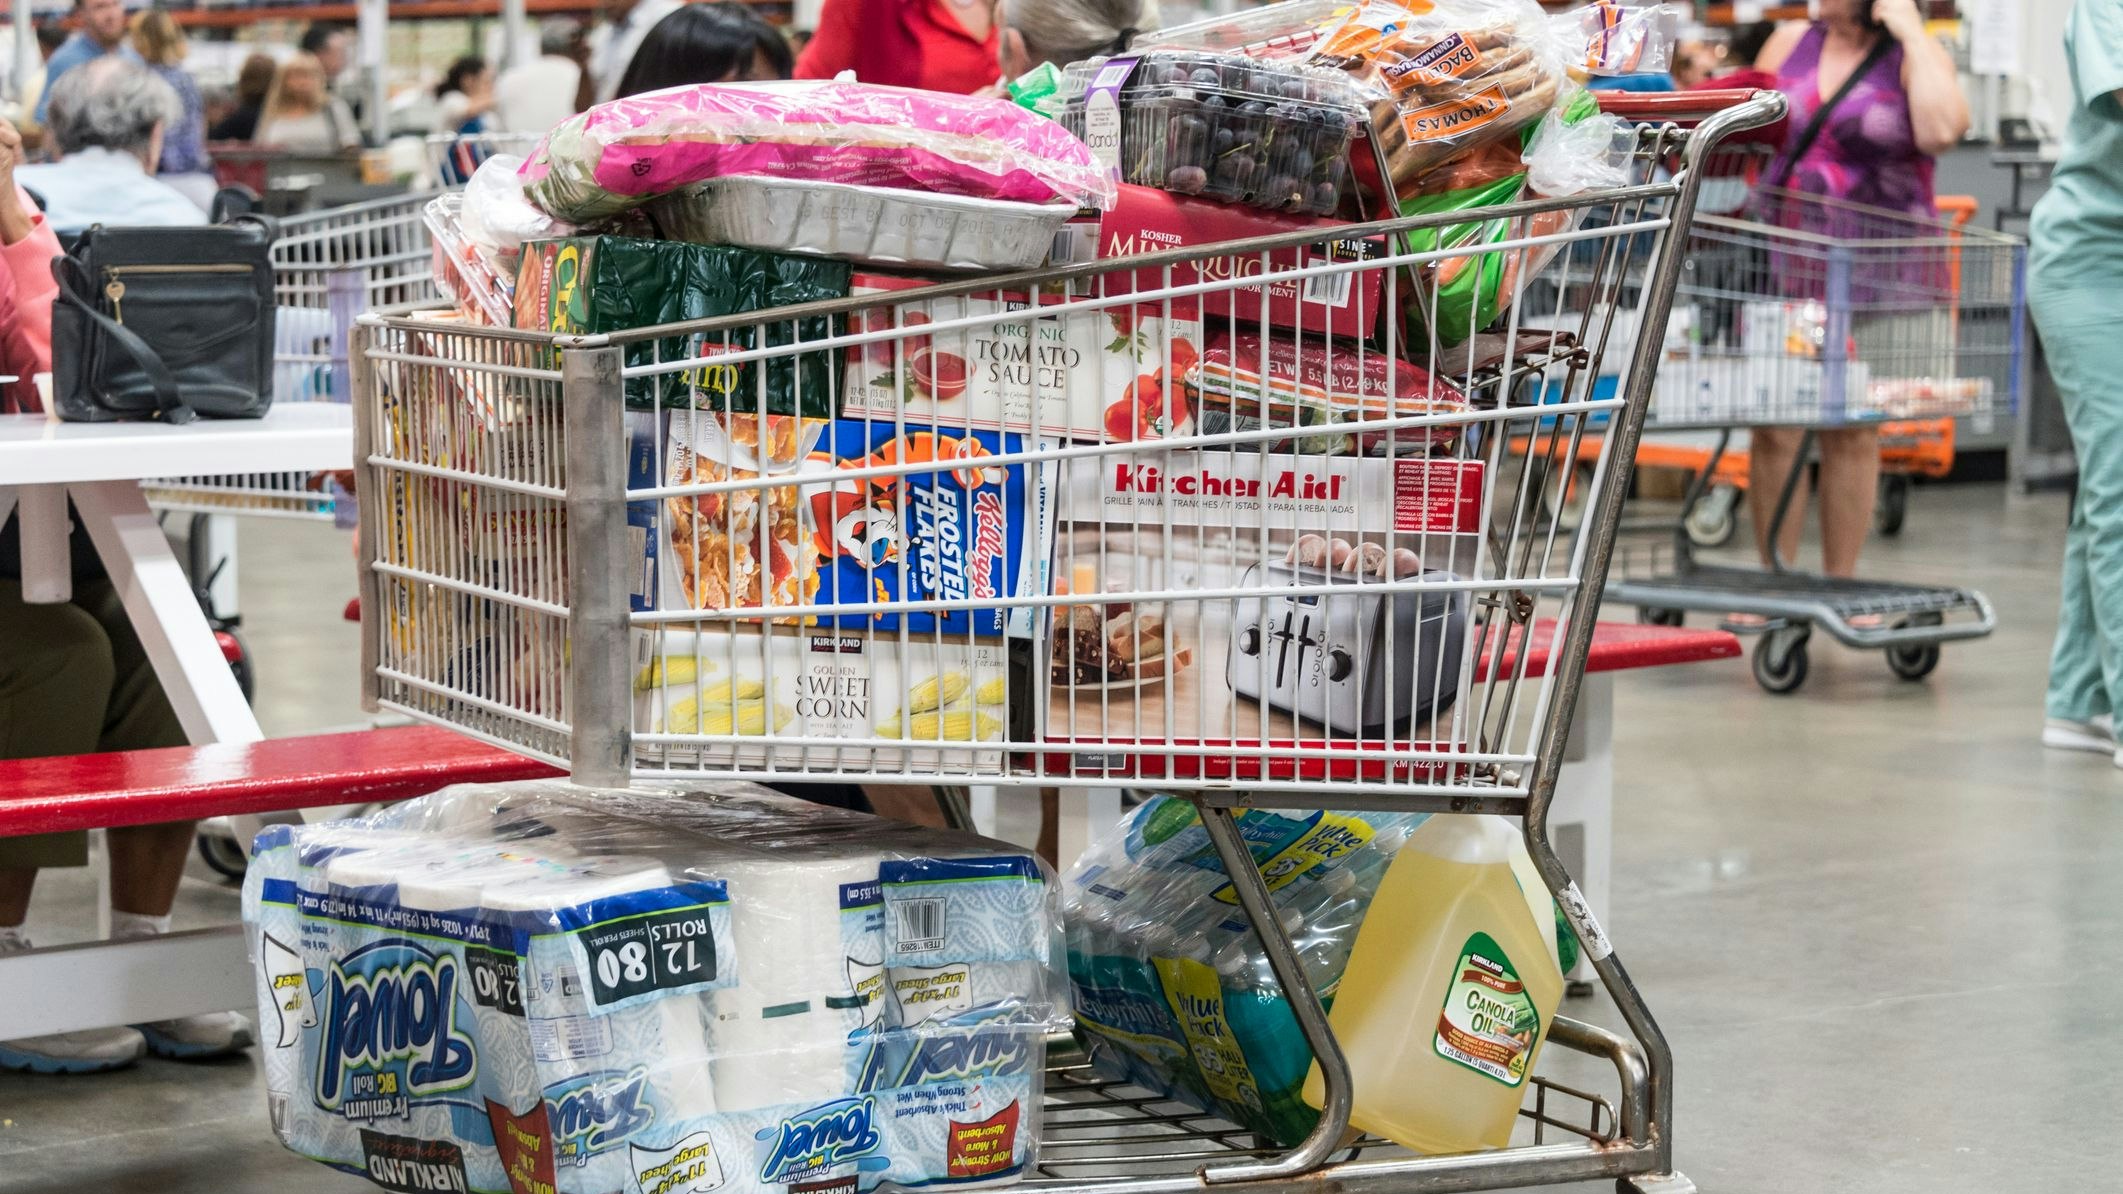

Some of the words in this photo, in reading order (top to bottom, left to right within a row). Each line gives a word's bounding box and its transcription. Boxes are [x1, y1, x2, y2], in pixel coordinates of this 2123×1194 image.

[1140, 229, 1182, 245] KOSHER
[538, 255, 553, 333] ORIGINA
[989, 362, 1065, 389] SAUCE
[1115, 464, 1340, 501] KitchenAid
[1104, 496, 1132, 506] GRILLE
[938, 486, 967, 601] FROSTED
[813, 637, 861, 648] KIRKAND
[977, 649, 988, 660] 12
[796, 698, 869, 721] CORN
[441, 920, 463, 936] 1026
[618, 927, 645, 941] SHEETS
[652, 918, 707, 941] ROLLS
[597, 941, 647, 988] 80
[661, 940, 702, 974] 12
[1472, 953, 1504, 973] KIRKLAND
[931, 971, 966, 987] Large
[1466, 989, 1515, 1024] CANOLA
[319, 957, 476, 1107] Towel
[1471, 1013, 1494, 1035] OIL
[353, 1074, 374, 1095] Roll
[377, 1071, 397, 1094] BIG
[896, 1090, 913, 1104] Wet
[345, 1096, 409, 1121] Premium
[895, 1104, 937, 1120] Absorbent
[762, 1098, 879, 1181] Towel
[965, 1140, 990, 1154] More
[672, 1143, 710, 1165] Large
[808, 1154, 824, 1168] BIG
[991, 1149, 1012, 1165] NOW
[370, 1155, 466, 1194] KIRKLAND
[777, 1162, 830, 1184] Premium
[789, 1161, 807, 1172] Roll
